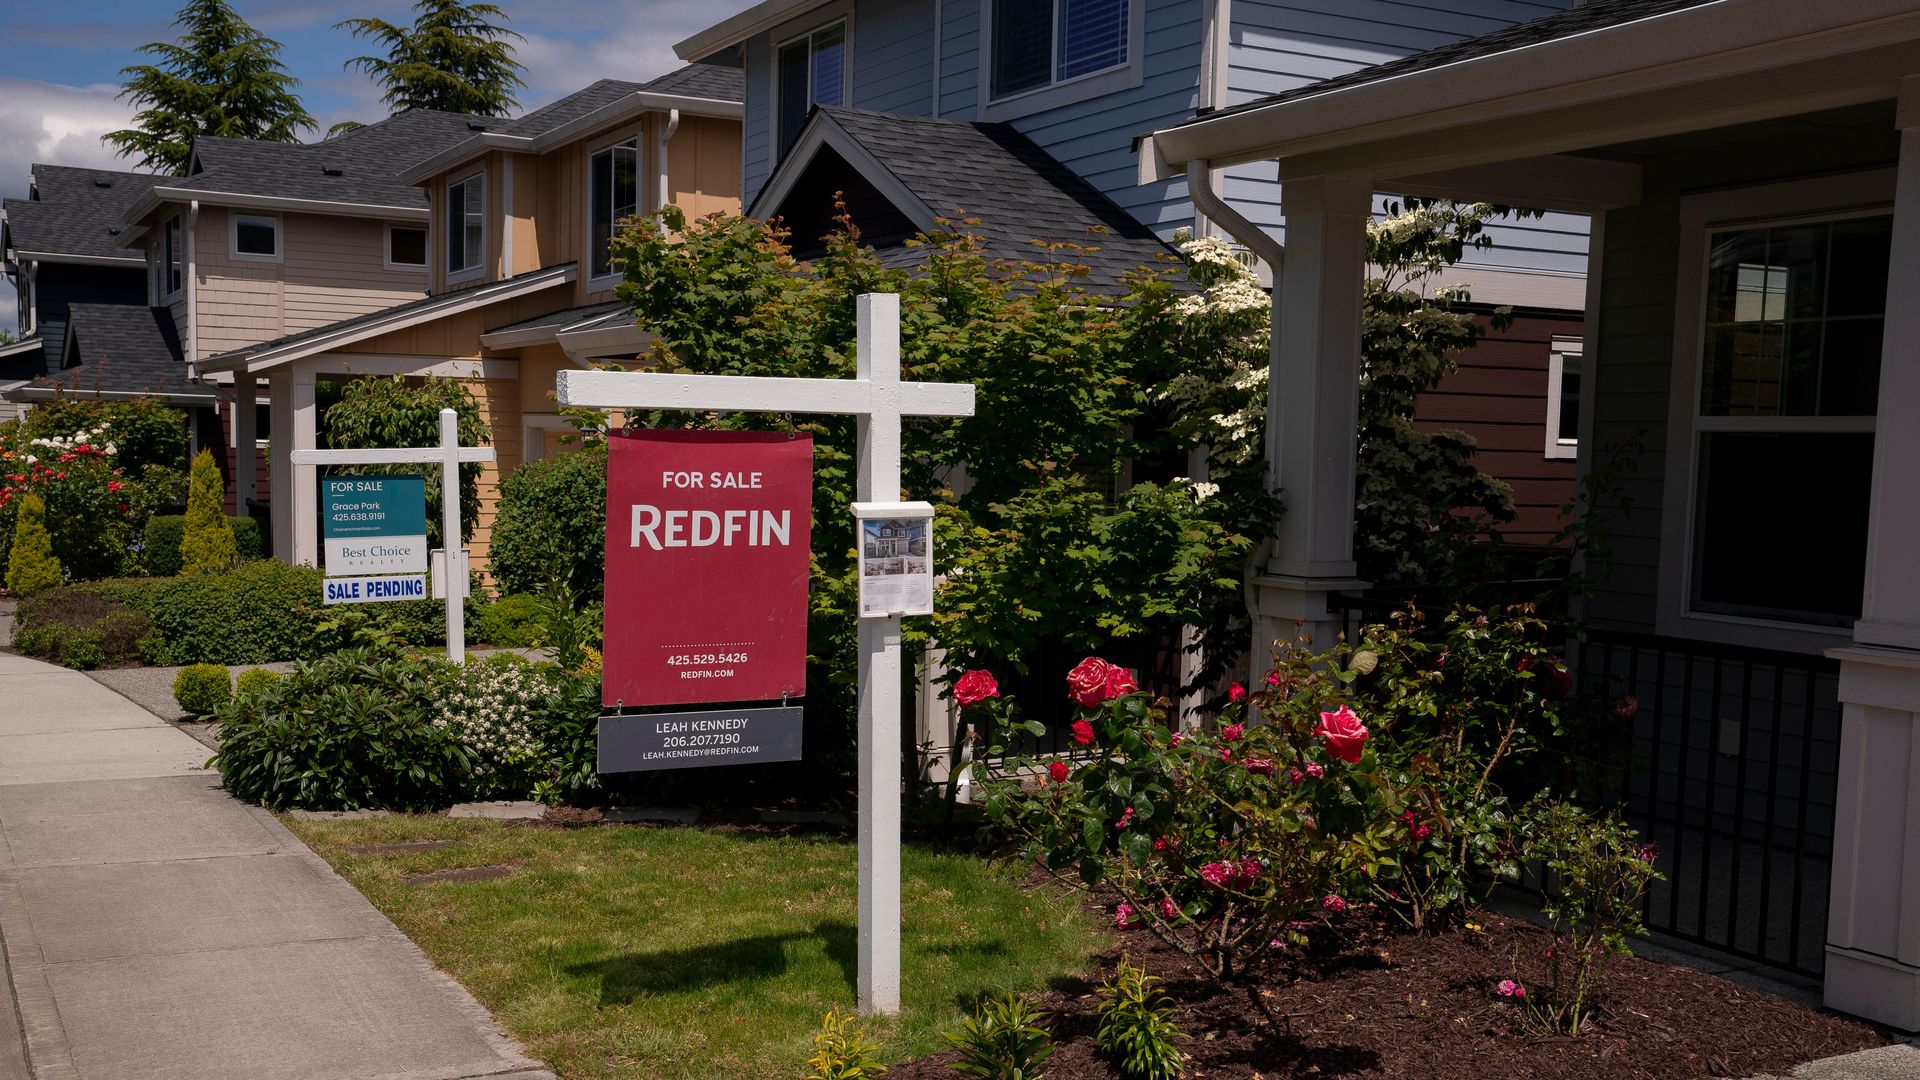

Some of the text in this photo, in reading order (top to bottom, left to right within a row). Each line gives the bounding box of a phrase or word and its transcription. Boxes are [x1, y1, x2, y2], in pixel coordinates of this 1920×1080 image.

[331, 481, 383, 492] FOR SALE
[662, 471, 763, 489] FOR SALE
[332, 502, 380, 511] Grace Park
[332, 512, 385, 521] 425.638.9191
[630, 504, 791, 551] REDFIN
[342, 545, 411, 558] Best Choice
[328, 579, 423, 600] SALE PENDING
[667, 652, 748, 665] 425.529.5426
[680, 669, 734, 679] REDFIN.COM
[656, 718, 748, 734] LEAH KENNEDY
[663, 733, 740, 747] 206.207.7190
[643, 745, 759, 760] LEAH.KENNEDY@REDFIN.COM
